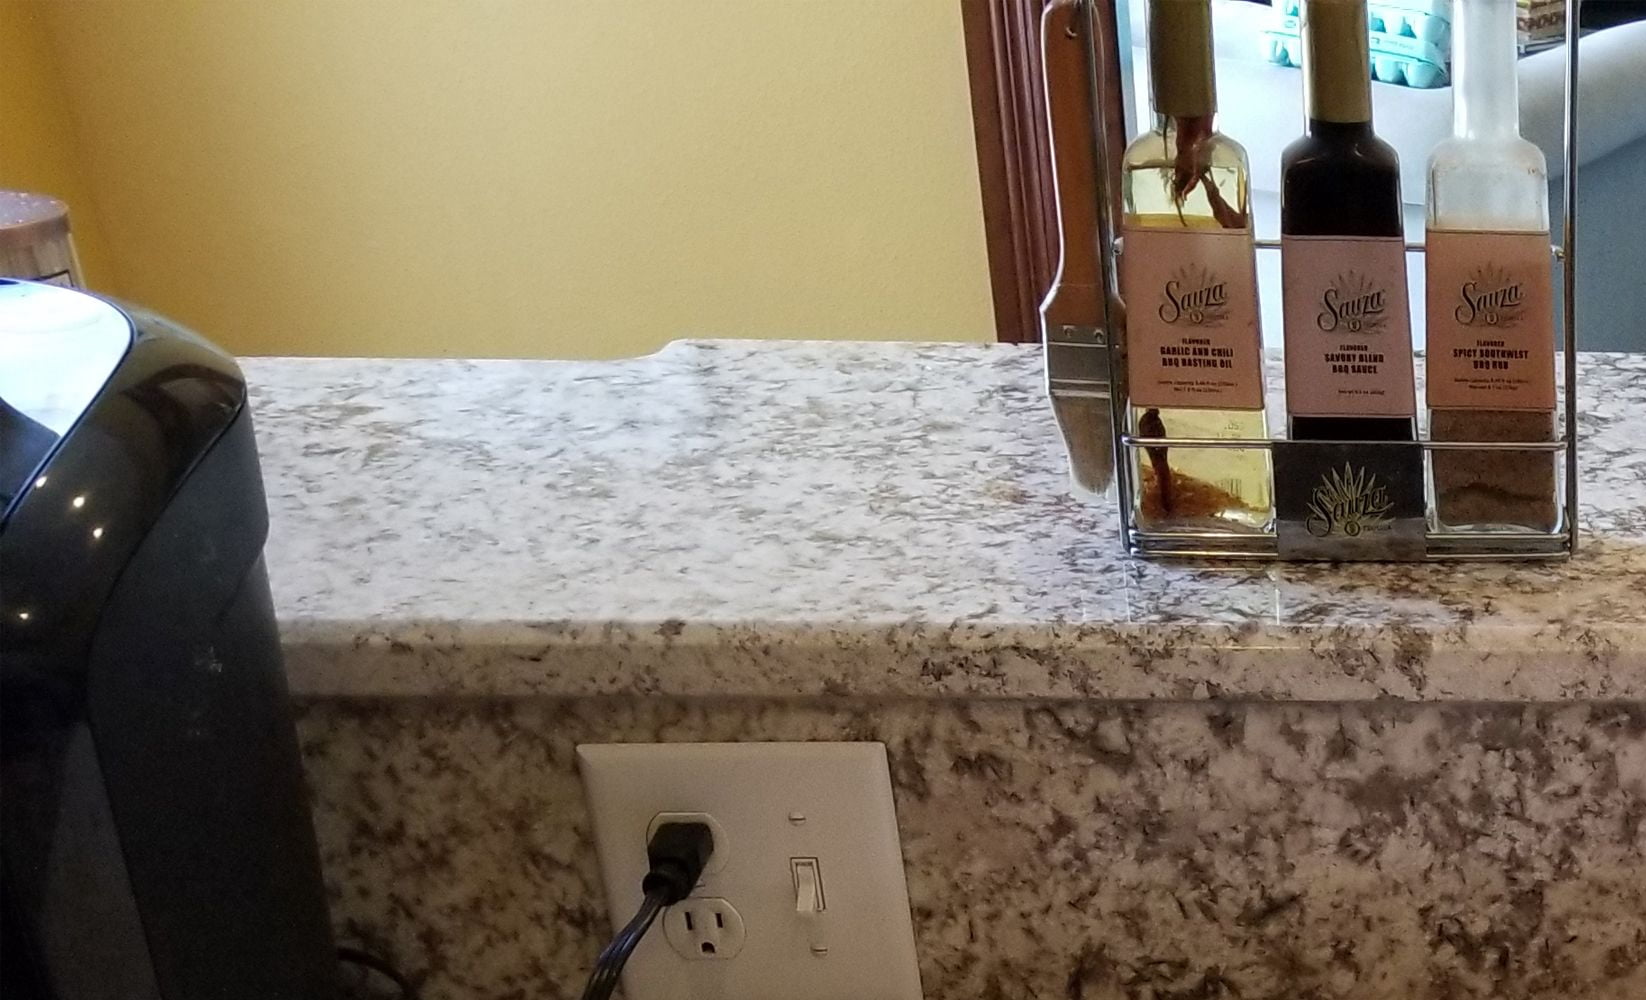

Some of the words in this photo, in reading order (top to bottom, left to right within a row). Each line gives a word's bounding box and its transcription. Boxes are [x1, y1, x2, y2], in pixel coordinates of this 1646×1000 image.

[1158, 280, 1228, 325] Sauza
[1455, 281, 1524, 325] Sauza
[1317, 288, 1386, 332] Sauza
[1160, 346, 1190, 356] GARLIC
[1192, 347, 1209, 356] AND
[1211, 348, 1233, 358] CHILI
[1324, 353, 1356, 363] SAVORY
[1358, 353, 1384, 363] BLEND
[1453, 348, 1477, 358] SPICY
[1479, 349, 1529, 359] SOUTHWEST
[1162, 357, 1179, 368] BBQ
[1181, 358, 1218, 368] BASTING
[1219, 359, 1233, 369] OIL
[1332, 364, 1349, 374] BBQ
[1351, 364, 1378, 374] SAUCE
[1473, 360, 1490, 370] BBQ
